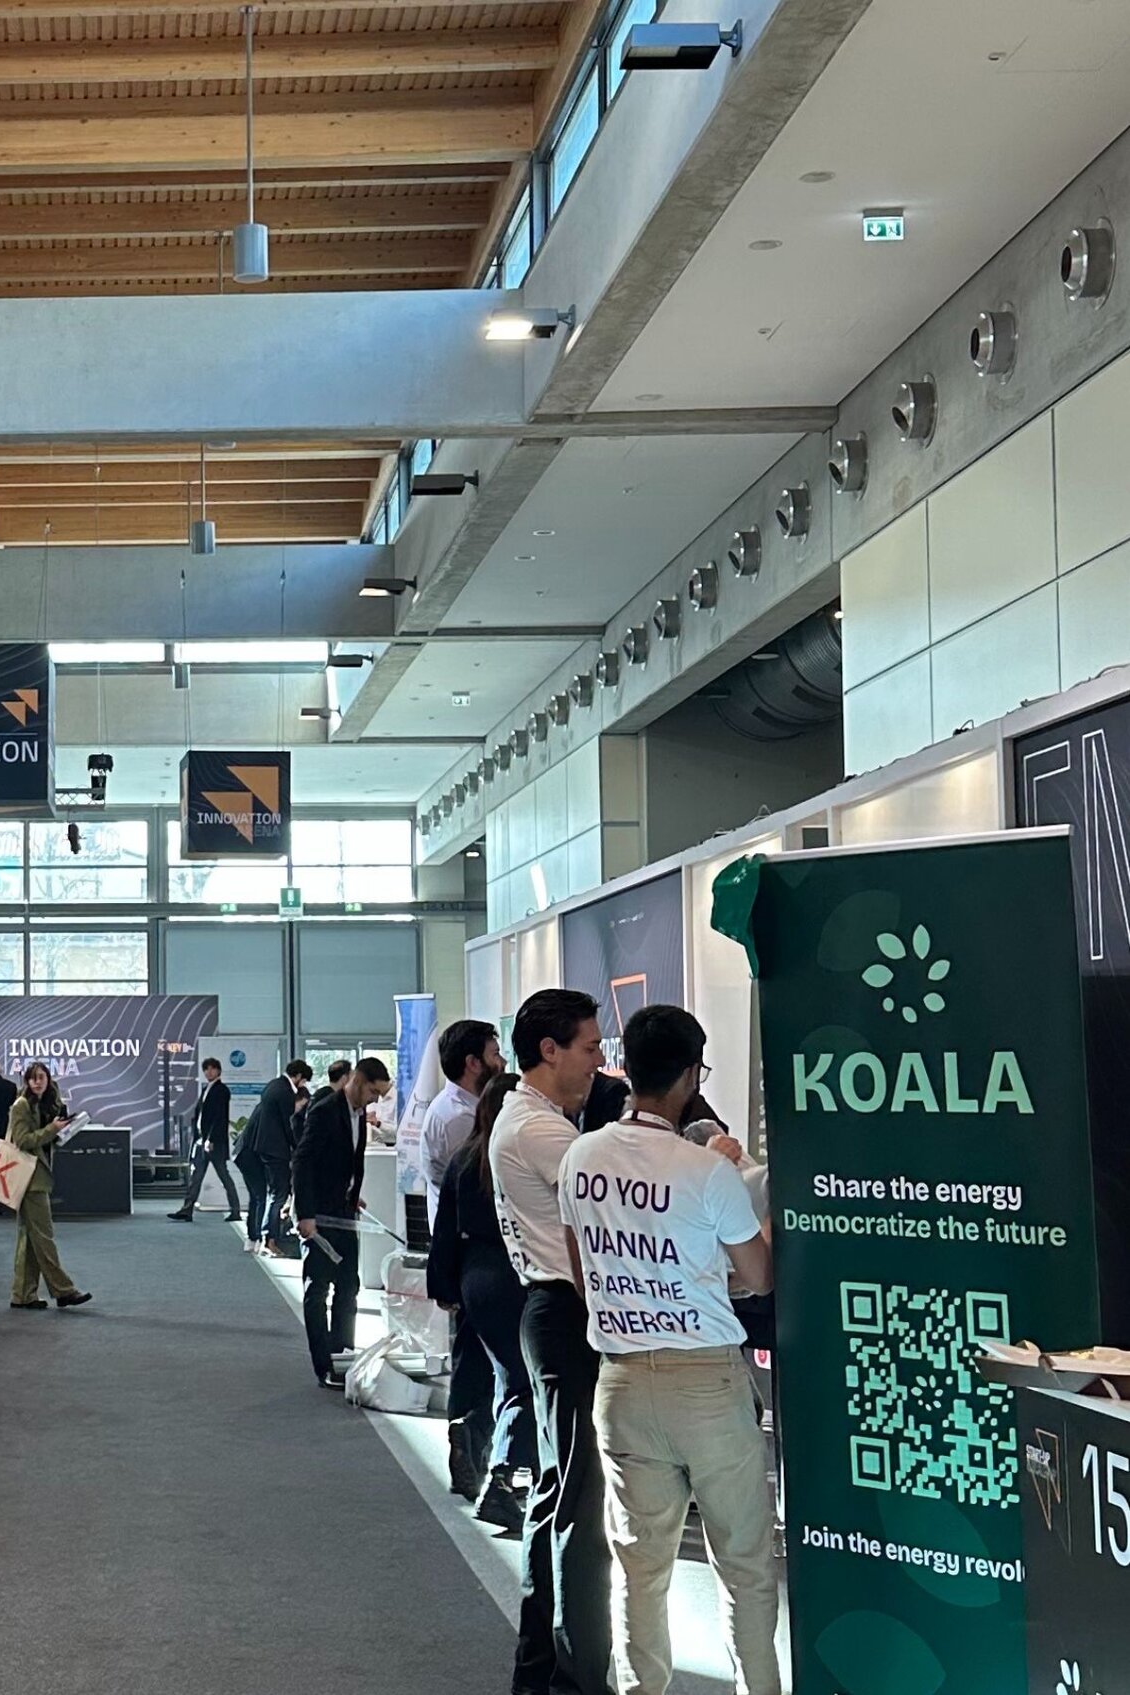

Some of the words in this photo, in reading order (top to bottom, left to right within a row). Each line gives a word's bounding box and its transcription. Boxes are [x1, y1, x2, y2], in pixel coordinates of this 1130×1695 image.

[196, 812, 282, 825] INNOVATION
[8, 1039, 141, 1058] INNOVATION
[792, 1051, 1035, 1115] KOALA
[576, 1171, 608, 1203] DO
[615, 1176, 671, 1214] YOU
[813, 1173, 887, 1200] Share
[890, 1175, 930, 1202] the
[935, 1181, 1023, 1212] energy
[783, 1208, 932, 1239] Democratize
[936, 1214, 980, 1242] the
[984, 1217, 1068, 1247] future
[589, 1271, 646, 1296] SARE
[644, 1279, 687, 1300] THE
[596, 1308, 701, 1335] ENERGY?
[1081, 1443, 1130, 1568] 15
[802, 1524, 844, 1551] Join
[847, 1531, 882, 1558] the
[885, 1542, 961, 1577] energy
[964, 1555, 1026, 1583] revol
